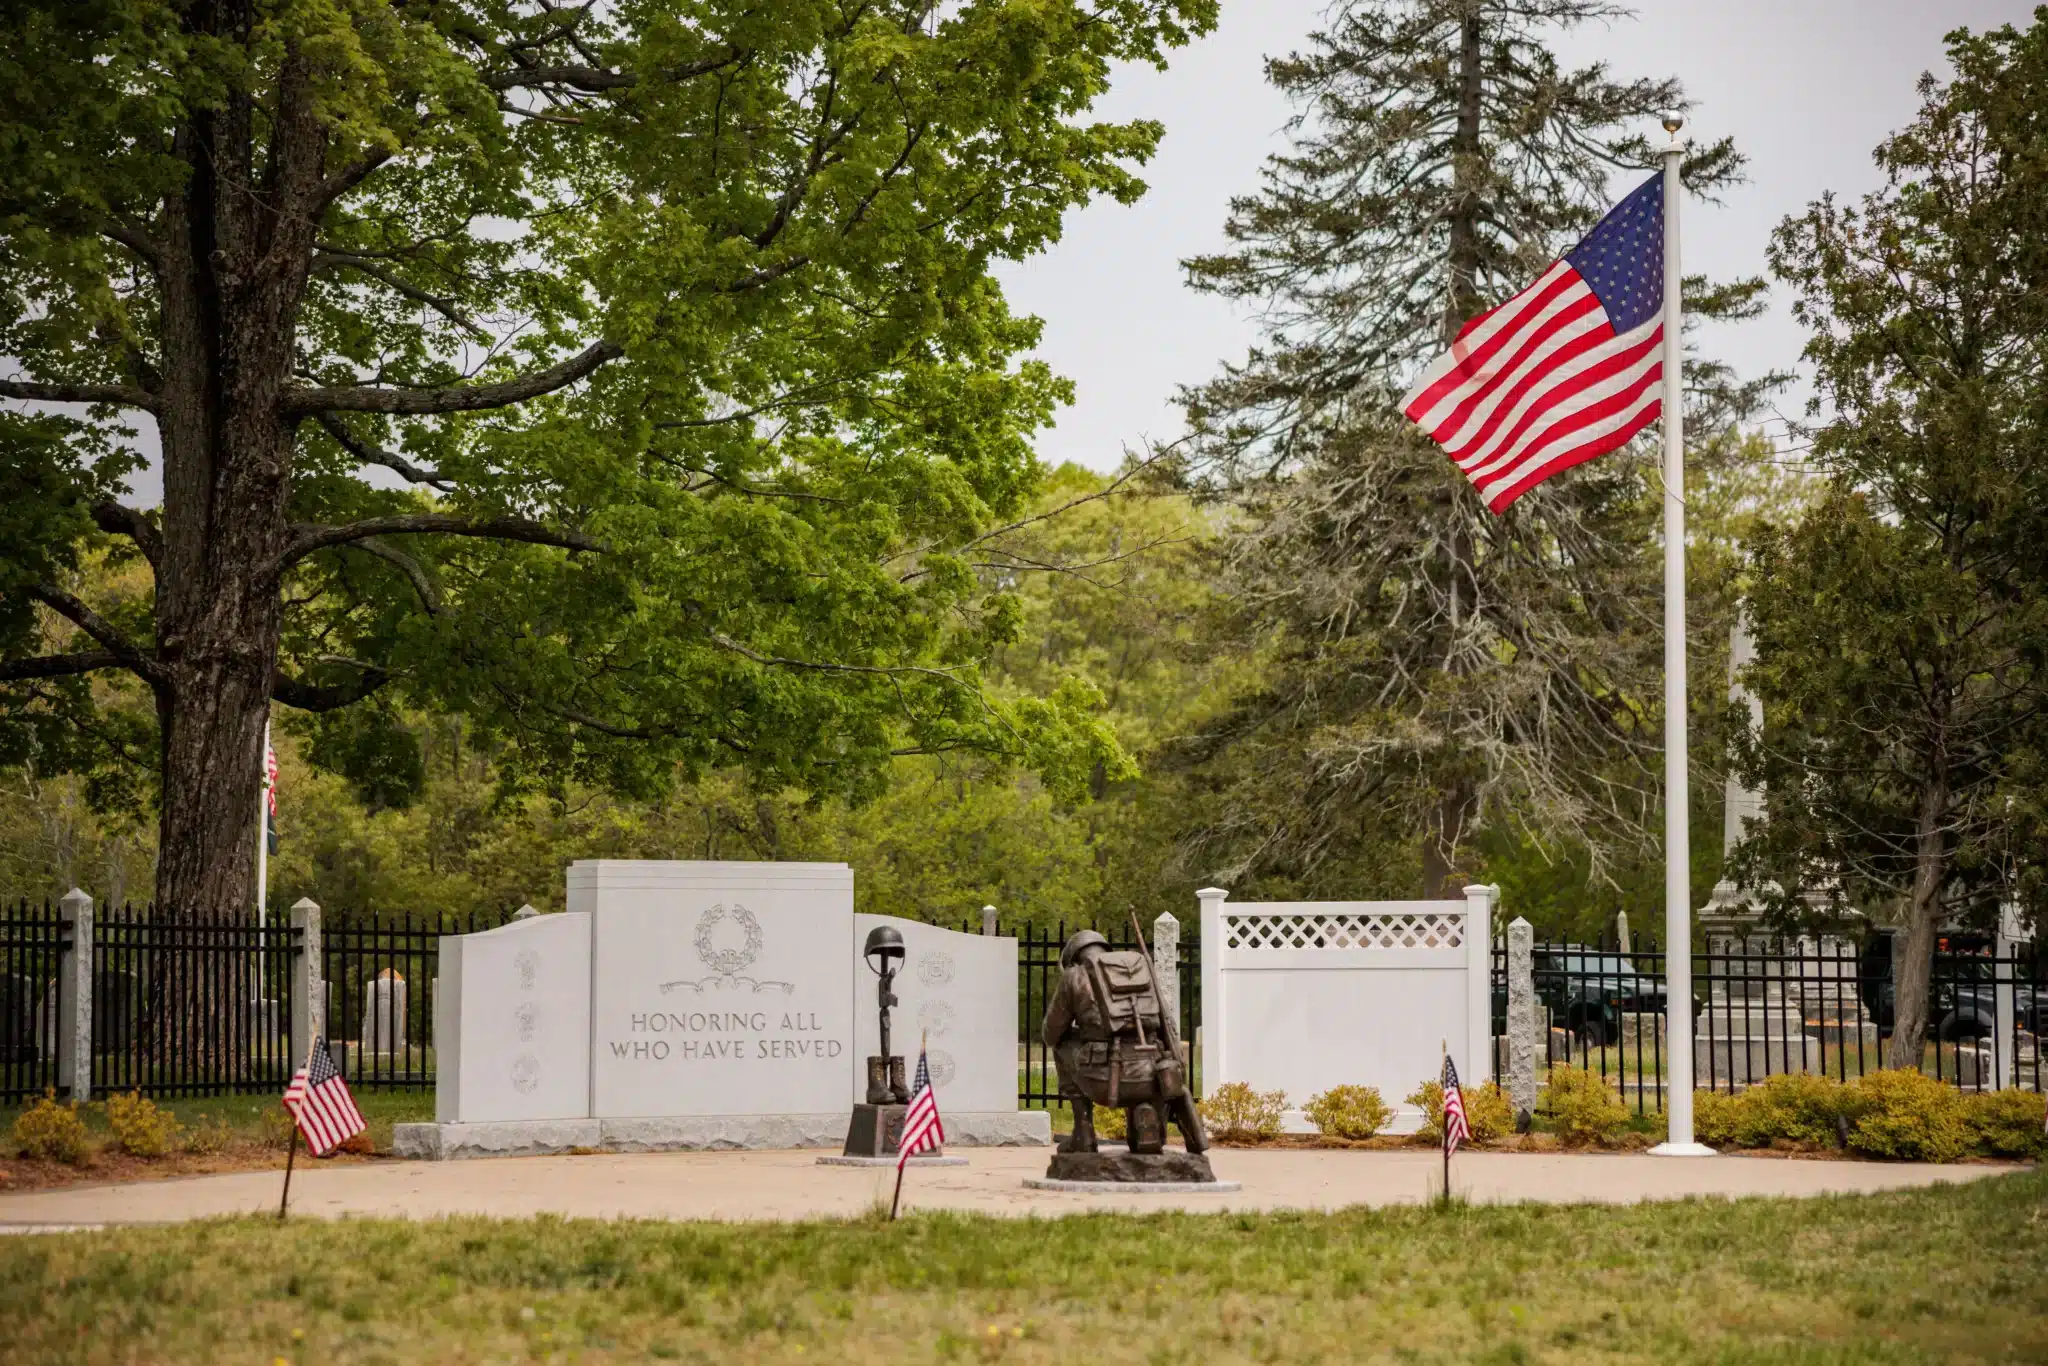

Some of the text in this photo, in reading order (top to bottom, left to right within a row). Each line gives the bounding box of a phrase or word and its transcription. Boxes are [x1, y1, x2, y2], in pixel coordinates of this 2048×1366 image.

[631, 1012, 823, 1032] HONORING ALL
[609, 1039, 842, 1060] WHO HAVE SERVED
